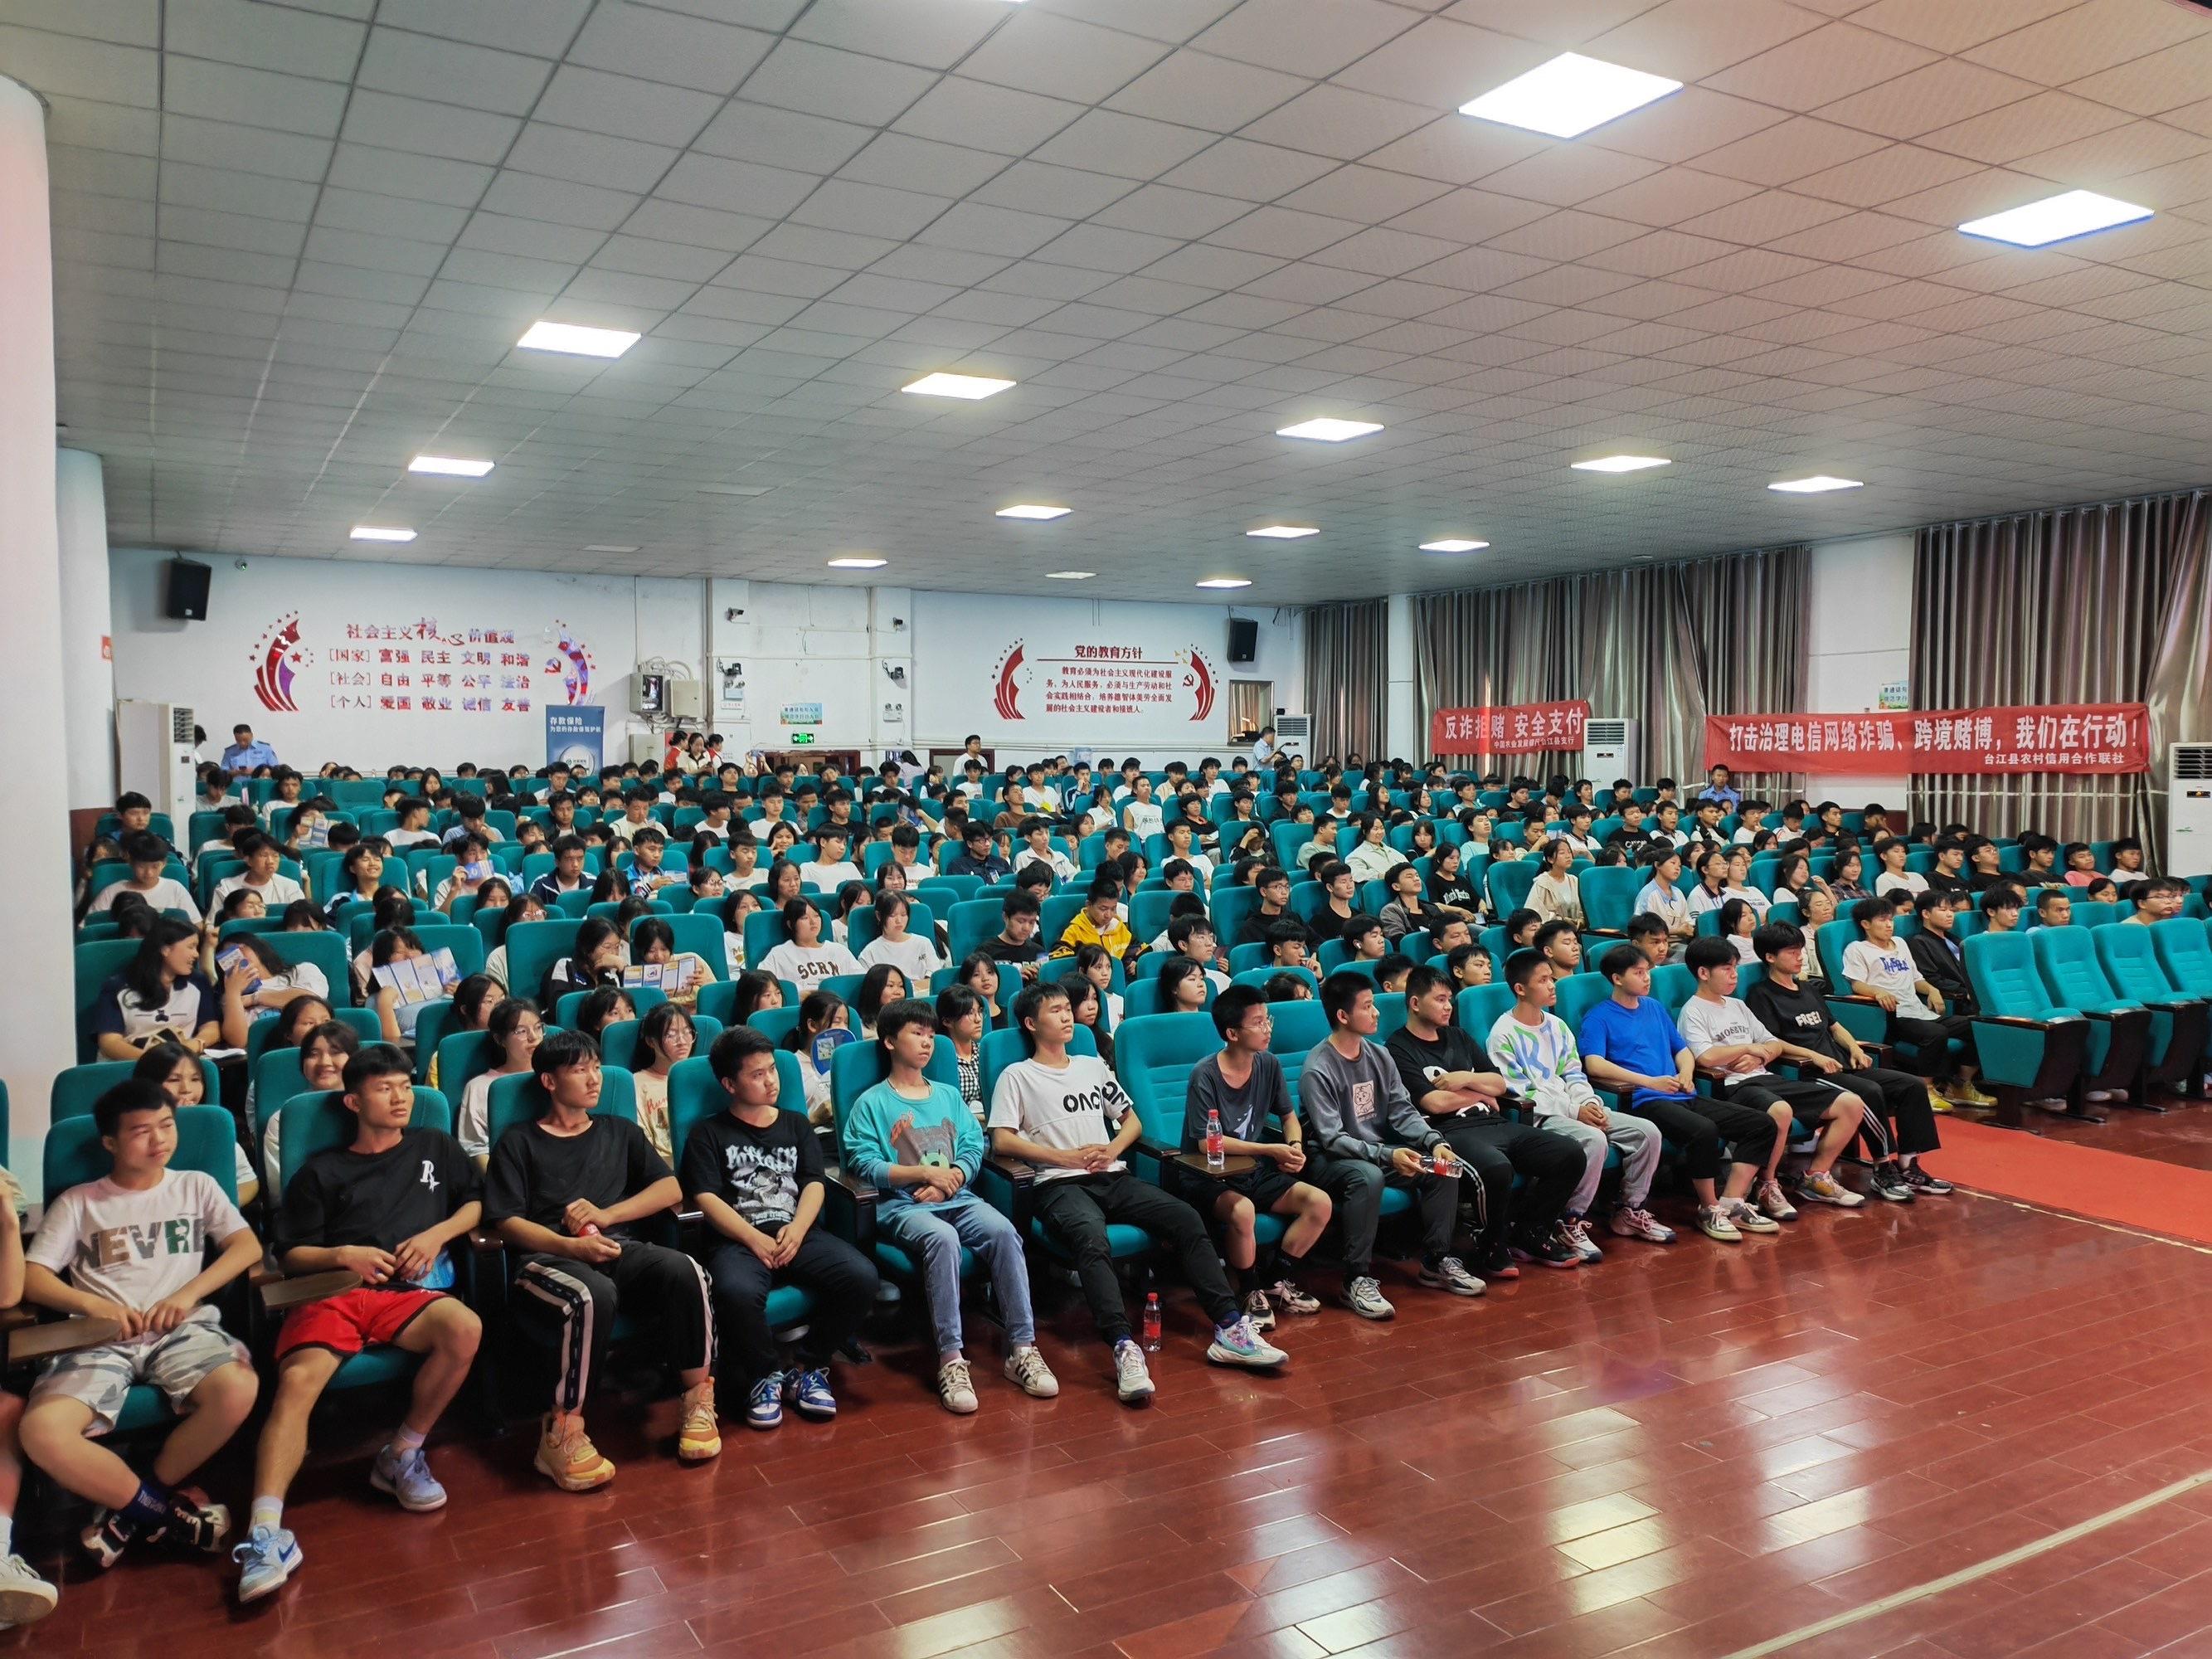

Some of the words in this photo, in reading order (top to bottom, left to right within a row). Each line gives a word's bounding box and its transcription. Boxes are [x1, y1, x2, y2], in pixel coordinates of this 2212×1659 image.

[379, 648, 411, 664] 富强
[421, 649, 451, 664] 民主
[461, 650, 491, 665] 文明
[500, 652, 530, 667] 和谐
[1075, 645, 1143, 659] 党的教育方针
[381, 672, 411, 687] 自由
[421, 673, 452, 688] 平等
[461, 674, 491, 688] 公平
[500, 674, 530, 689] 法治
[380, 695, 411, 711] 爱国
[421, 695, 452, 711] 敬业
[462, 697, 492, 712] 诚信
[501, 698, 531, 713] 友善
[550, 717, 582, 725] 存款保险
[1445, 713, 1505, 740] 反诈拒赌
[1514, 707, 1583, 739] 安全支付
[1984, 752, 2125, 765] 台江县农村信用合作联社
